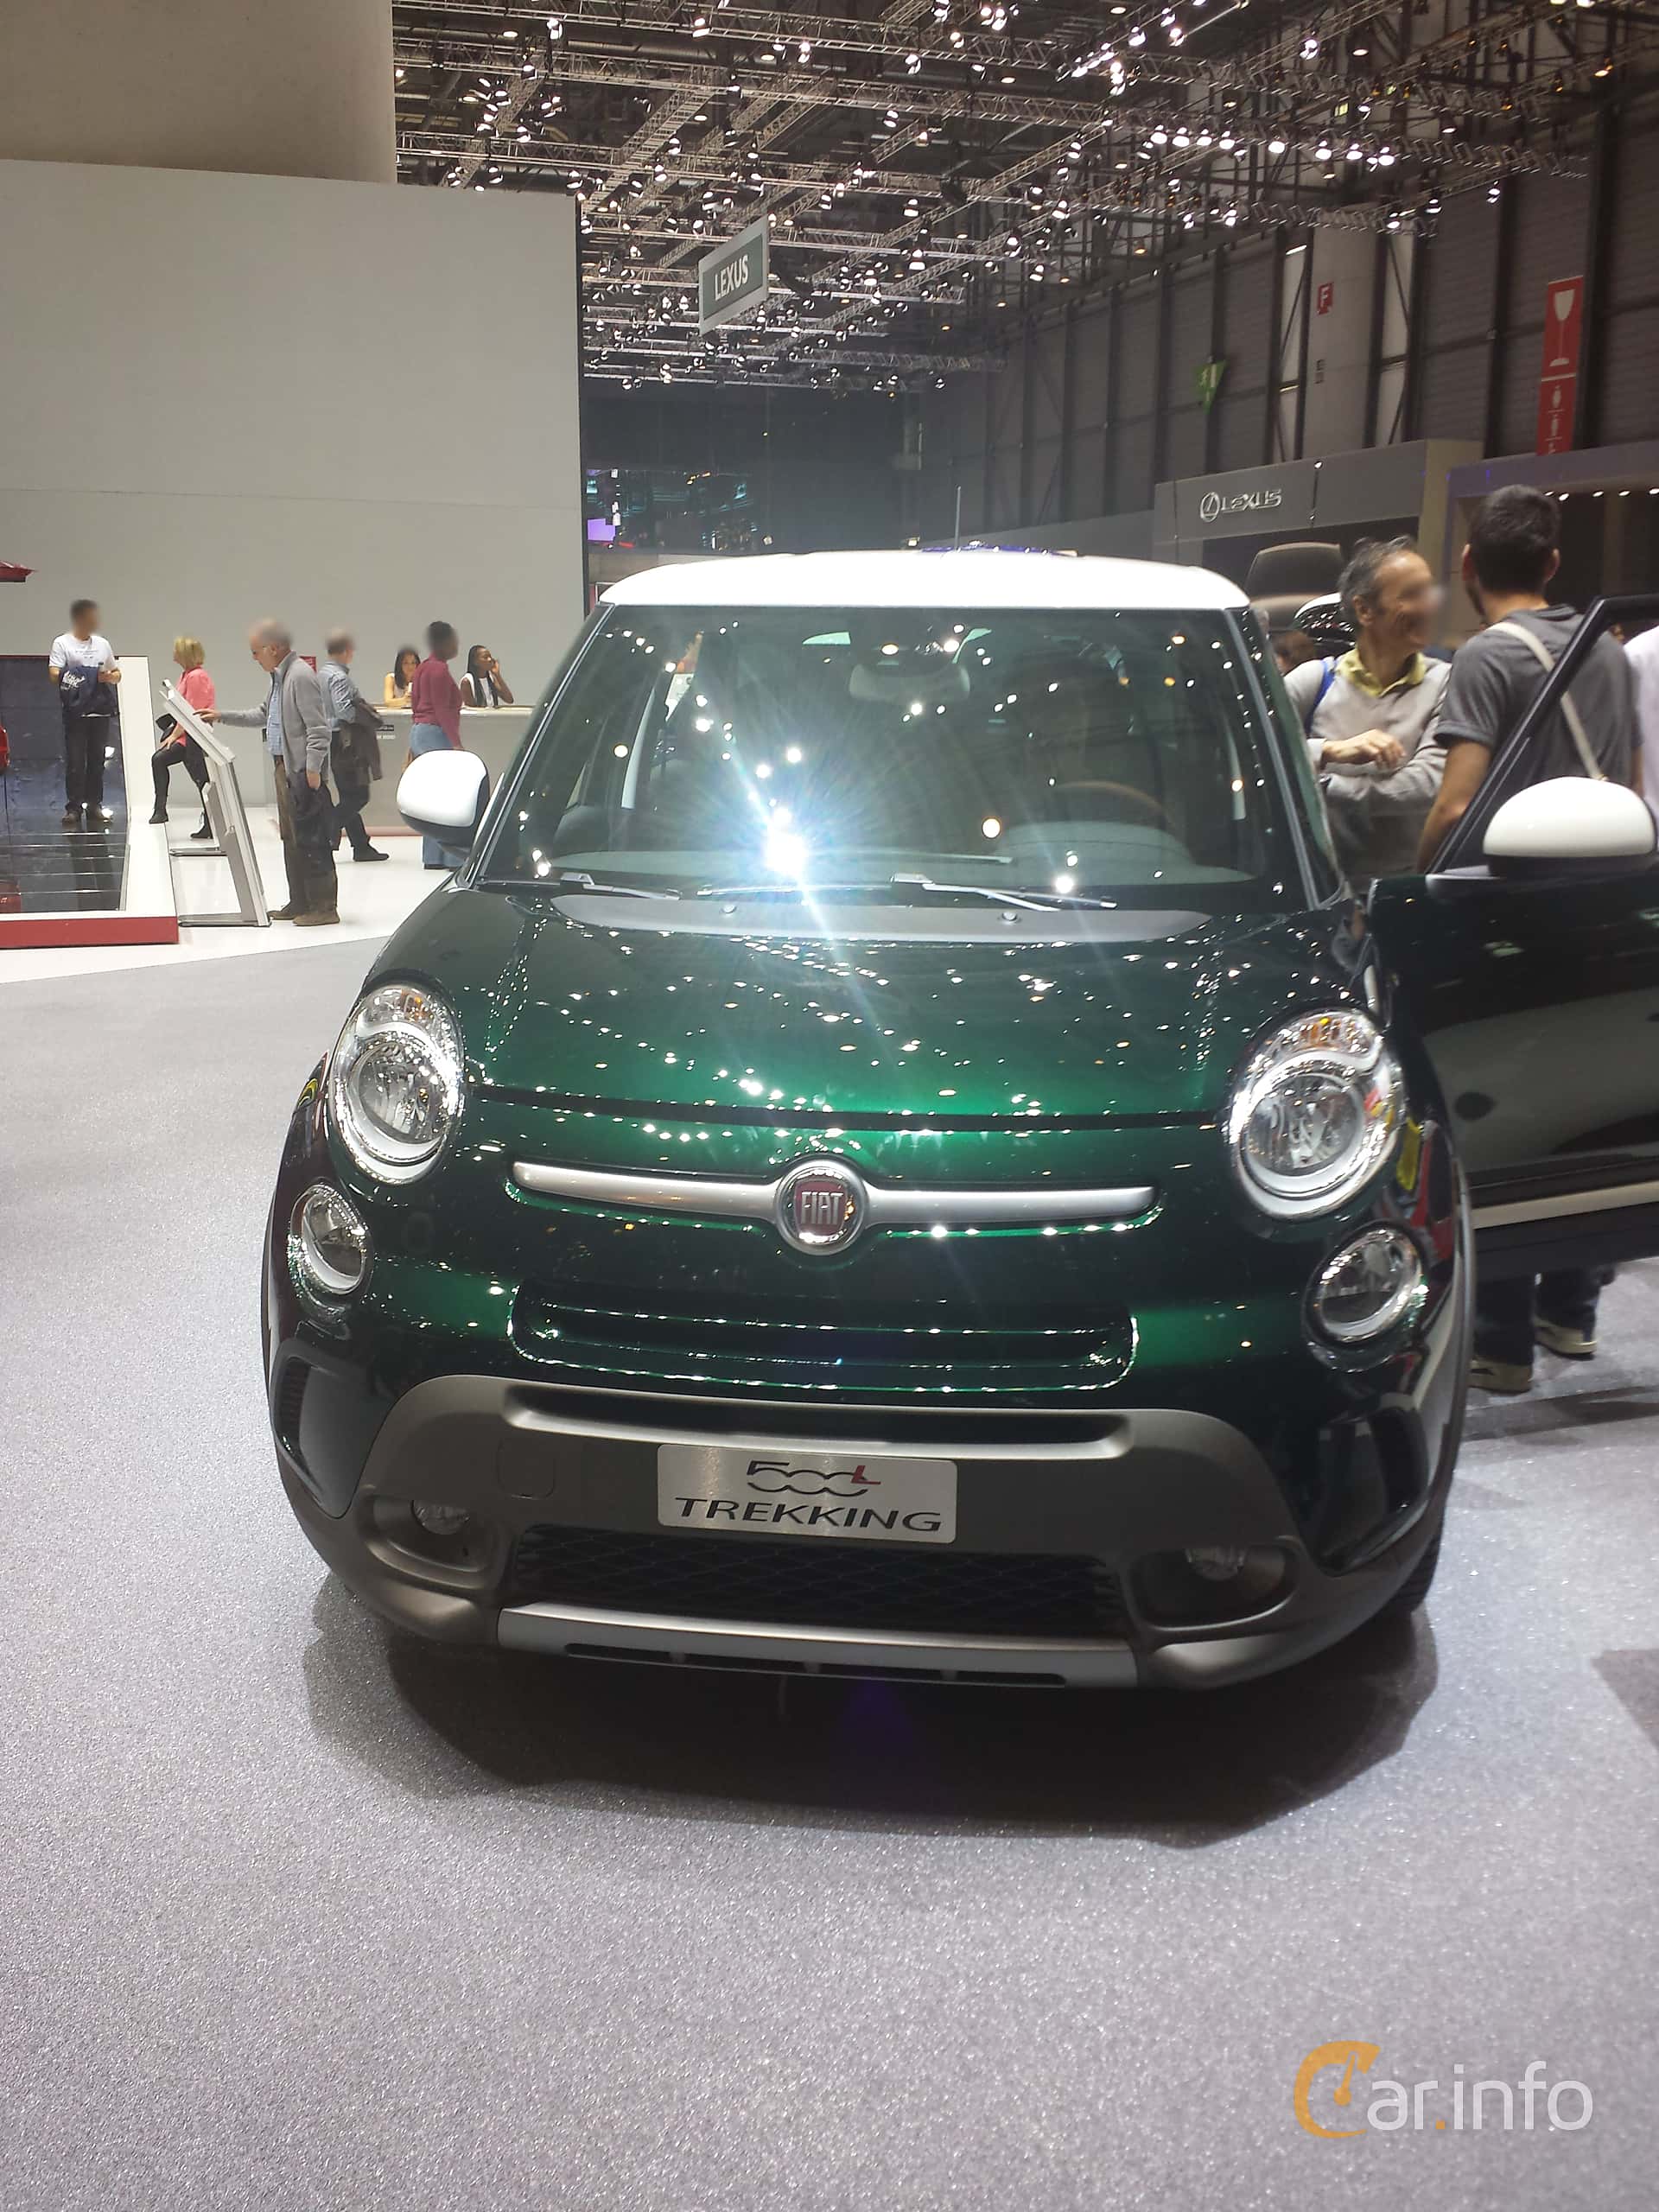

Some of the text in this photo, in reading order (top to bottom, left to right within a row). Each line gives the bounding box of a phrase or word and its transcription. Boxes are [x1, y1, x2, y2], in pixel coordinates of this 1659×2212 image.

[715, 255, 748, 302] LEXUS
[1221, 488, 1282, 513] LEXUS
[800, 1192, 844, 1224] FIAT
[674, 1497, 943, 1532] TREKKING
